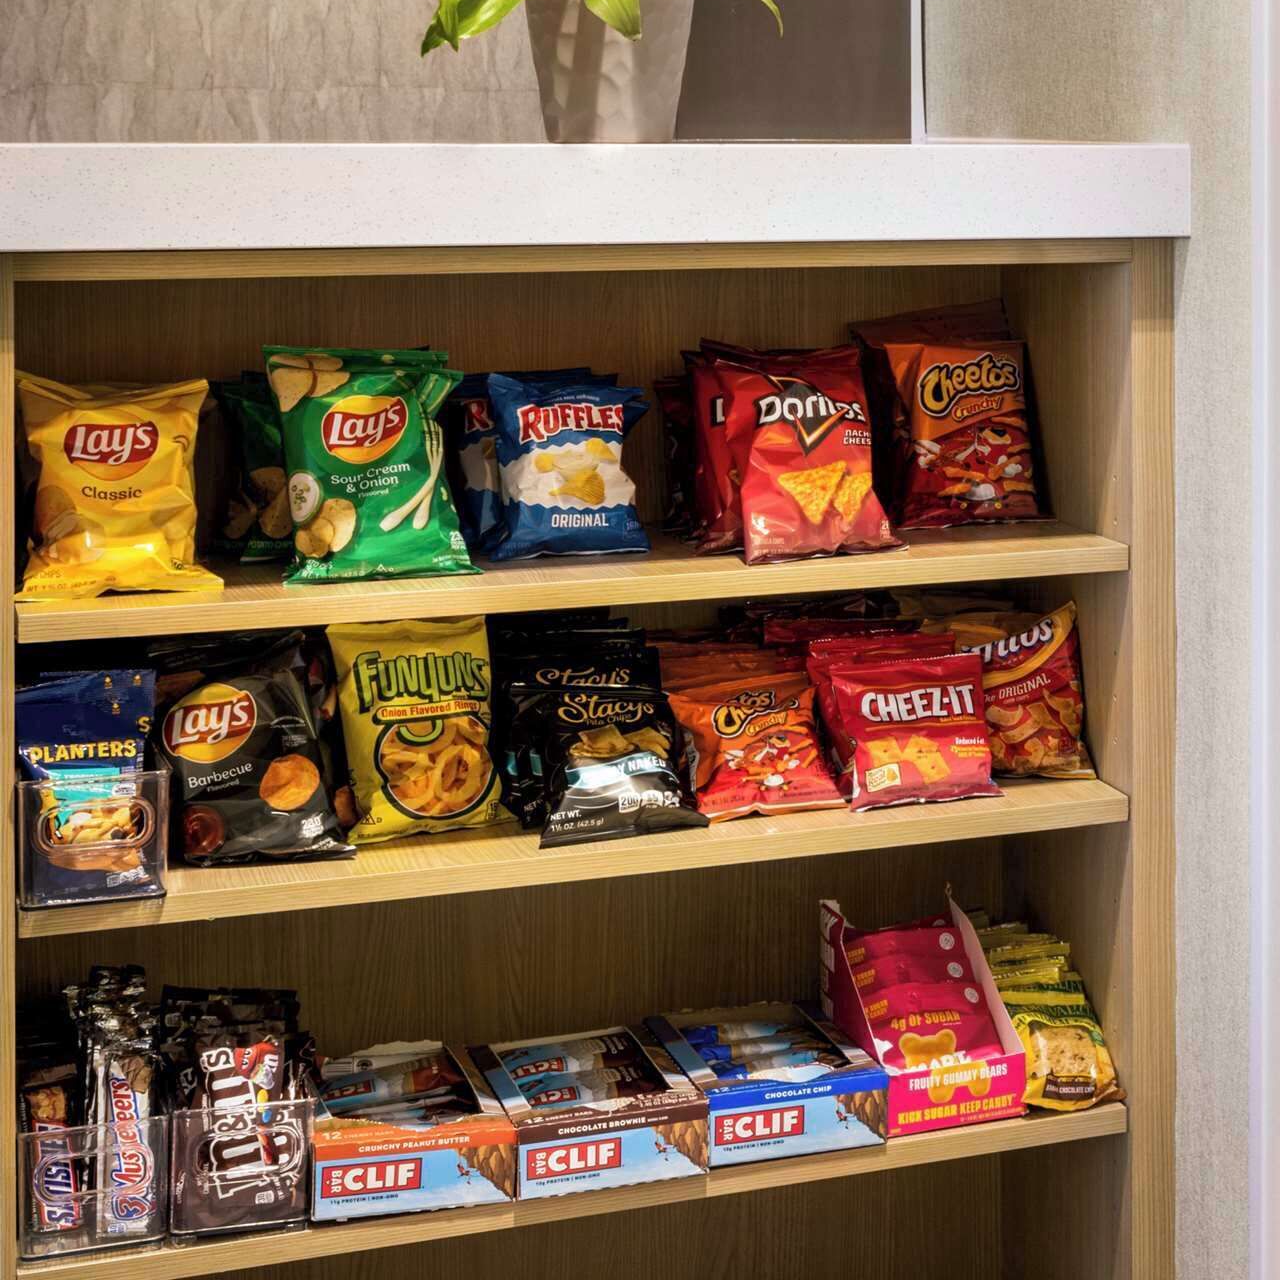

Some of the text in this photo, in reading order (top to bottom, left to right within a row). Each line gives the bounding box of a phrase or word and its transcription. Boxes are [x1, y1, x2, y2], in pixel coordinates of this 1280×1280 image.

[920, 353, 1018, 416] Cheetos
[758, 392, 866, 425] Doritos
[952, 396, 1002, 422] Crunchy
[328, 402, 401, 449] Lay's
[845, 428, 871, 438] NACH
[71, 423, 153, 465] Lay's
[843, 437, 872, 445] CHEES
[330, 462, 411, 485] Sour Cream
[346, 475, 399, 494] & Onion
[81, 486, 143, 501] Classic
[551, 512, 609, 529] ORIGINAL
[968, 618, 1053, 663] ritos
[998, 673, 1052, 699] ORIGINAL
[381, 700, 477, 718] Onion Flavored Rings
[861, 684, 975, 722] CHEEZ-IT
[171, 698, 250, 746] Lay's
[28, 739, 137, 765] PLANTERS
[187, 761, 254, 789] Barbecue
[550, 811, 568, 821] NET
[891, 1018, 906, 1031] 4g
[909, 1076, 941, 1091] FRUITY
[943, 1068, 978, 1085] GUMMY
[764, 1085, 833, 1099] CHOCOLATE CHIP
[898, 1110, 922, 1124] KICK
[924, 1105, 958, 1120] SUGAR
[960, 1099, 981, 1114] KEEP
[982, 1094, 1014, 1109] CANDY
[322, 1131, 342, 1140] 12
[558, 1122, 608, 1135] CHOCOLATE
[609, 1117, 646, 1128] BROWNIE
[723, 1119, 733, 1140] BAR
[734, 1110, 799, 1138] CLIF
[359, 1136, 470, 1153] CRUNCHY PEANUT BUTTER
[536, 1152, 547, 1175] BAR
[548, 1142, 615, 1172] CLIF
[331, 1170, 343, 1193] BAR
[343, 1163, 416, 1191] CLIF
[341, 1196, 366, 1204] PROTEIN
